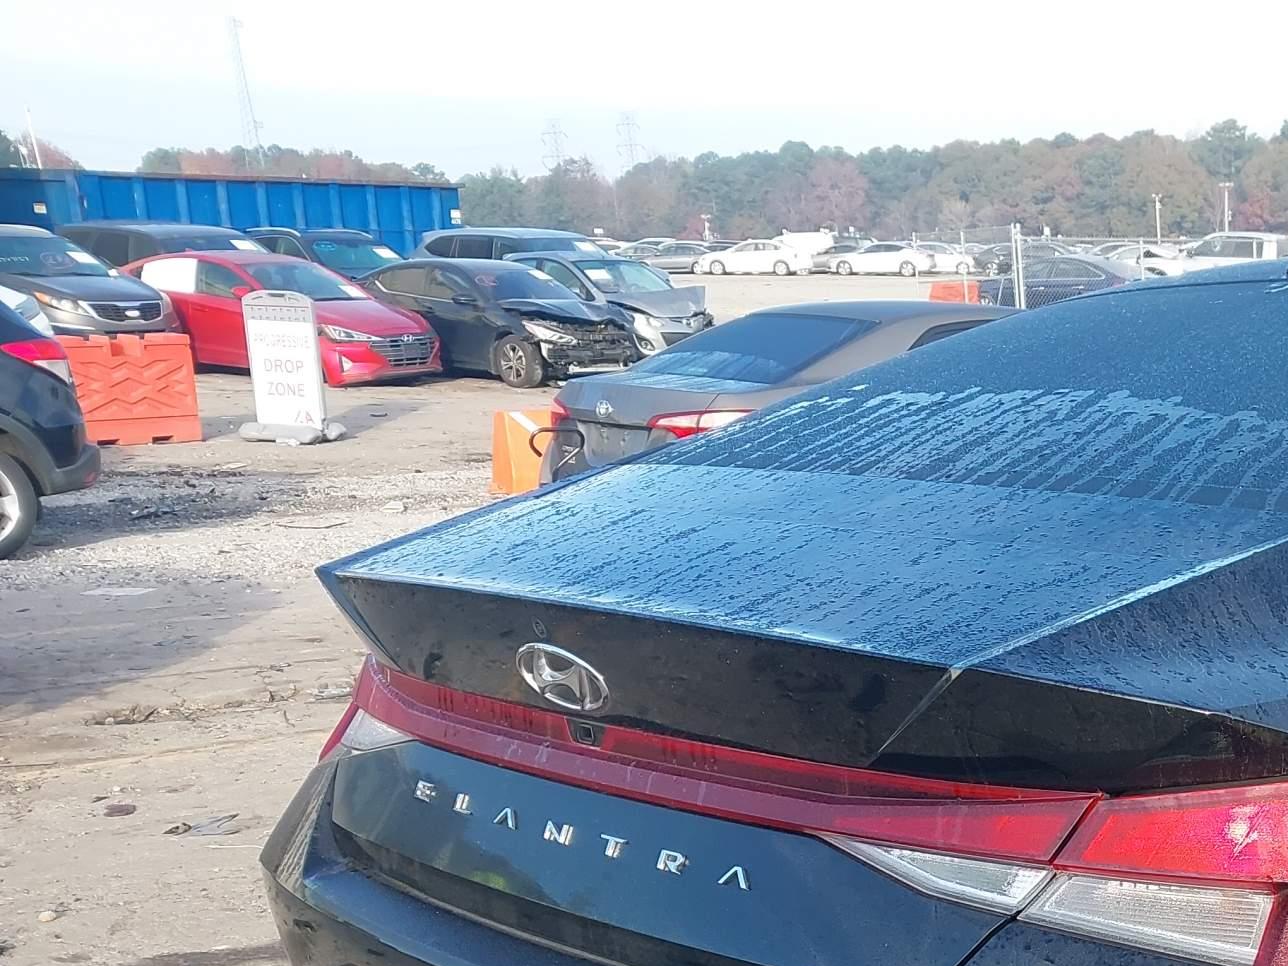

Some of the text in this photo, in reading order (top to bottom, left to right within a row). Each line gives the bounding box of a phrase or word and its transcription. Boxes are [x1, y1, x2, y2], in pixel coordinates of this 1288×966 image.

[263, 358, 304, 373] DROP
[266, 381, 305, 398] ZONE
[413, 778, 752, 891] ELANTRA
